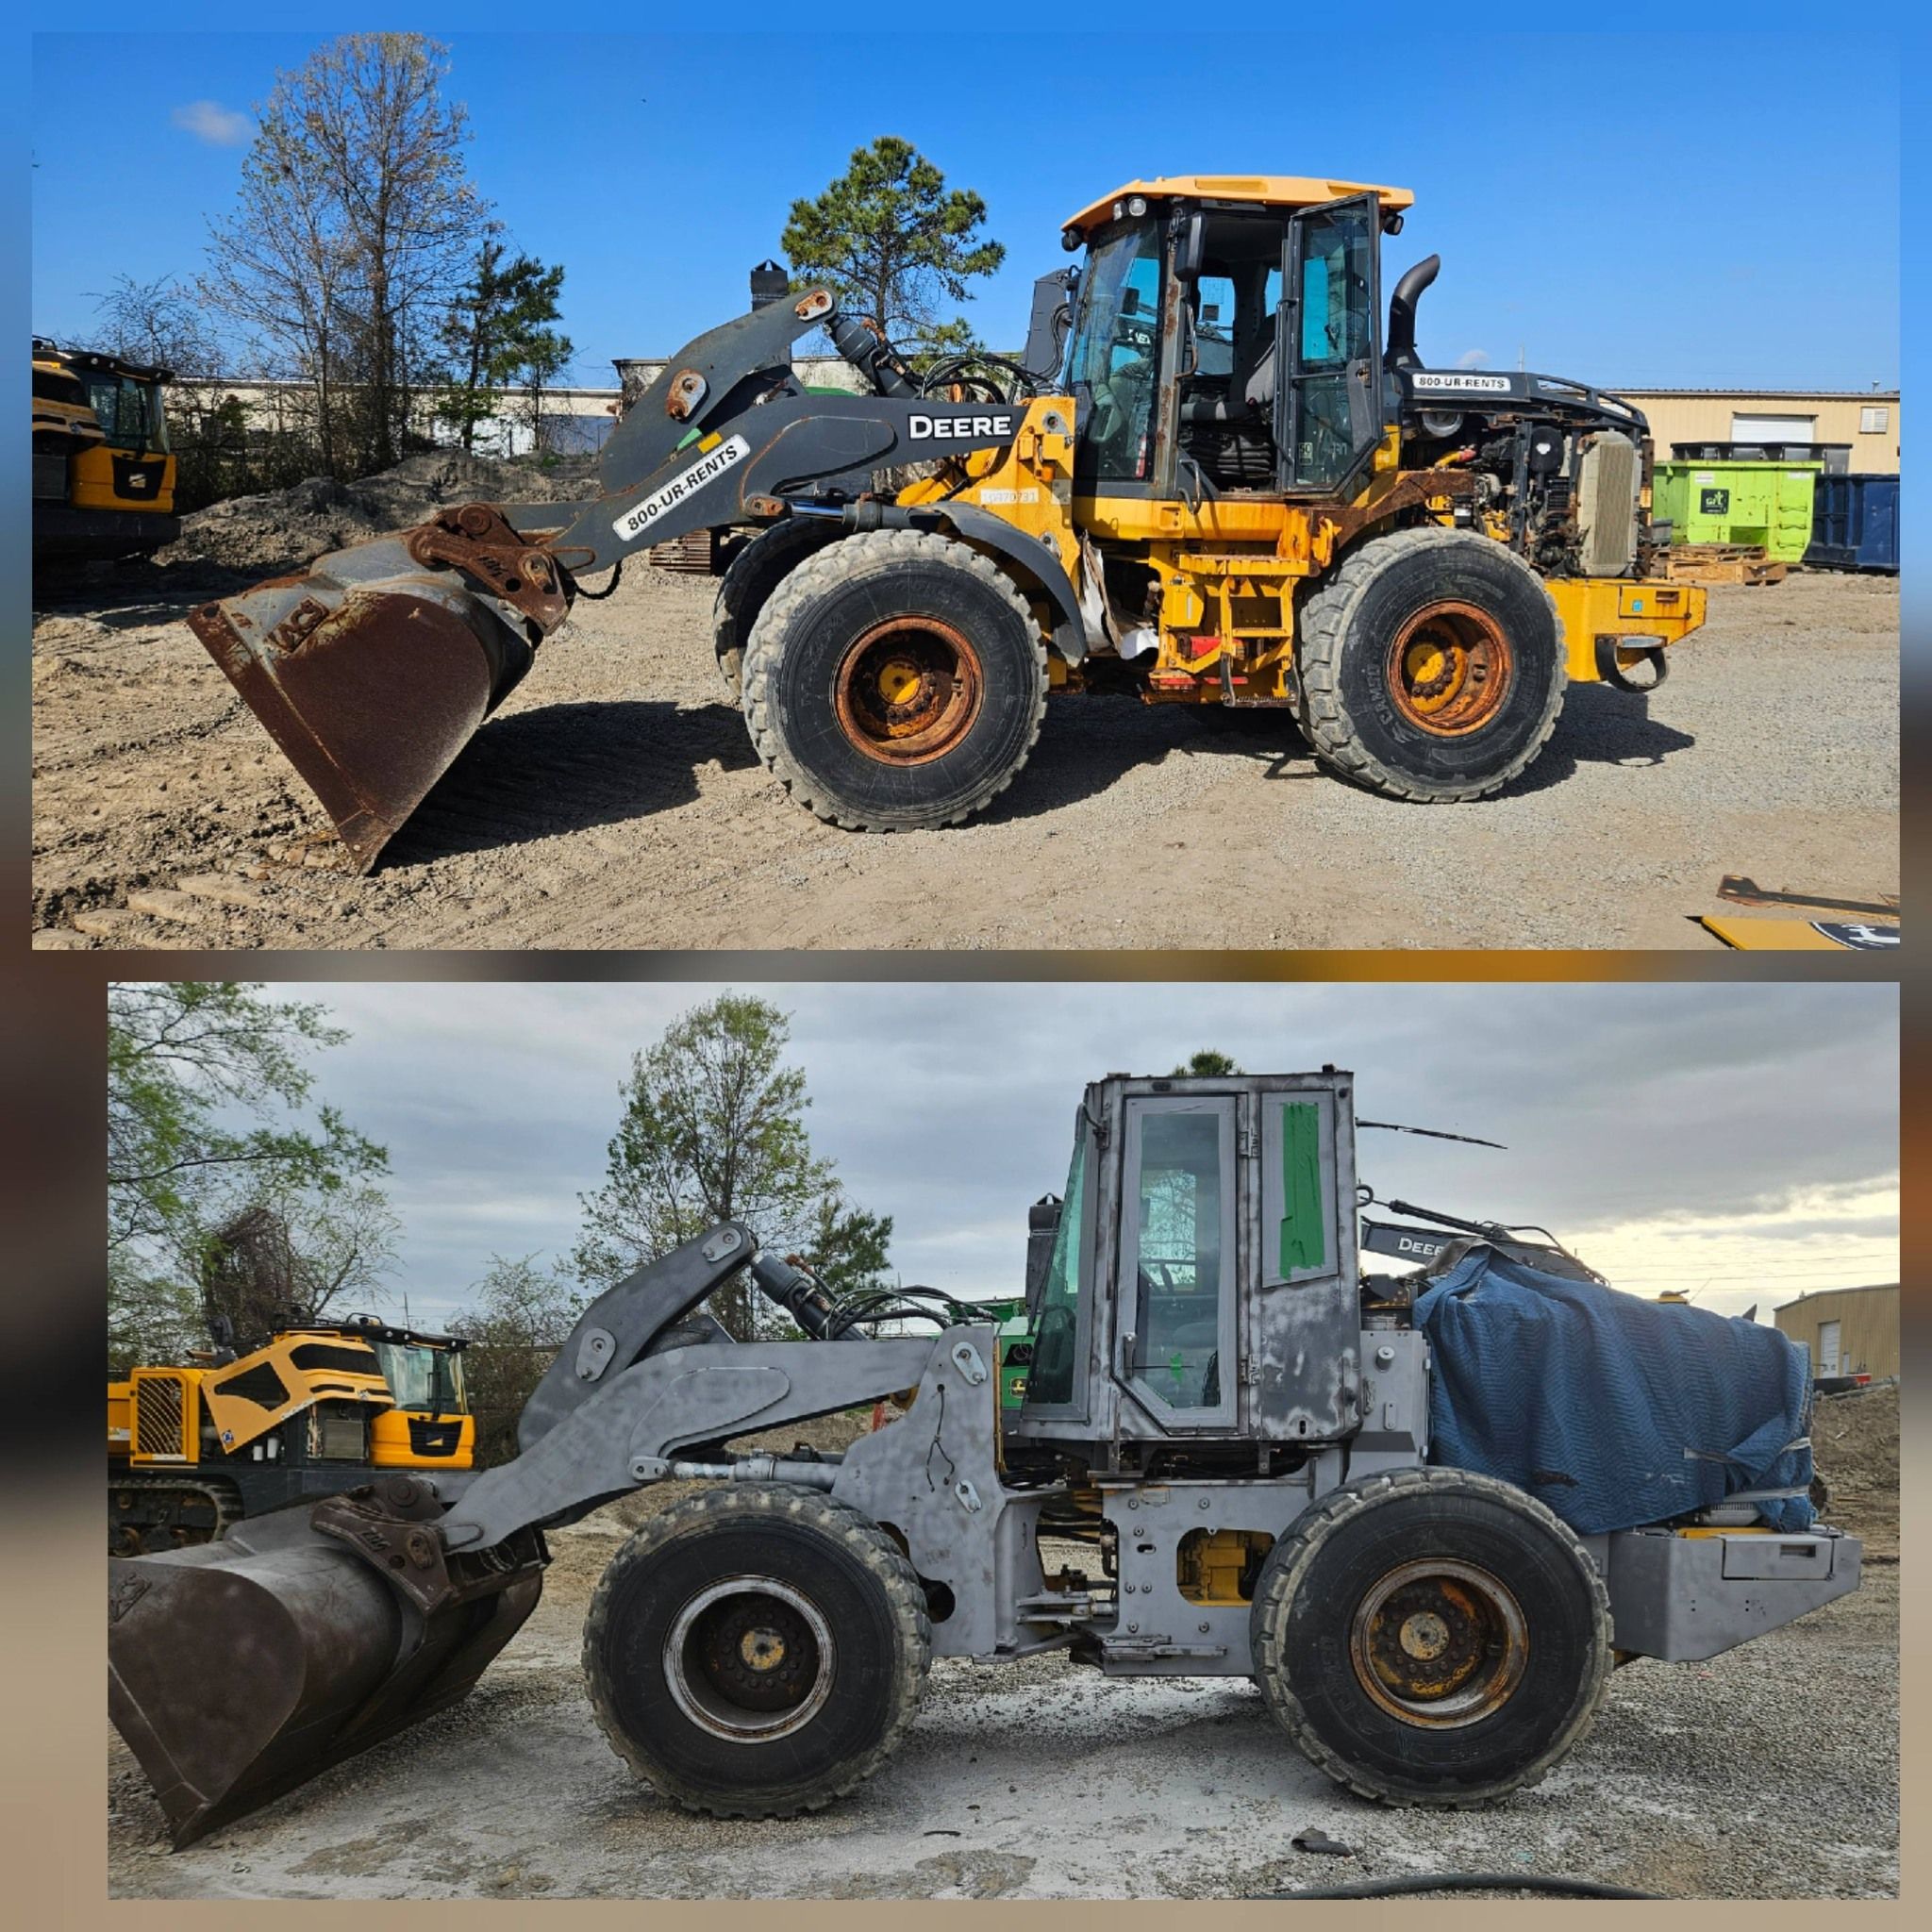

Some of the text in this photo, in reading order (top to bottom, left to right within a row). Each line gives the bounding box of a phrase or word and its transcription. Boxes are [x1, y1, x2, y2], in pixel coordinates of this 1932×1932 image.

[1418, 376, 1506, 389] 800-UR-RENTS
[908, 415, 1012, 440] DEERE
[626, 444, 739, 531] 800-UR-RENTS
